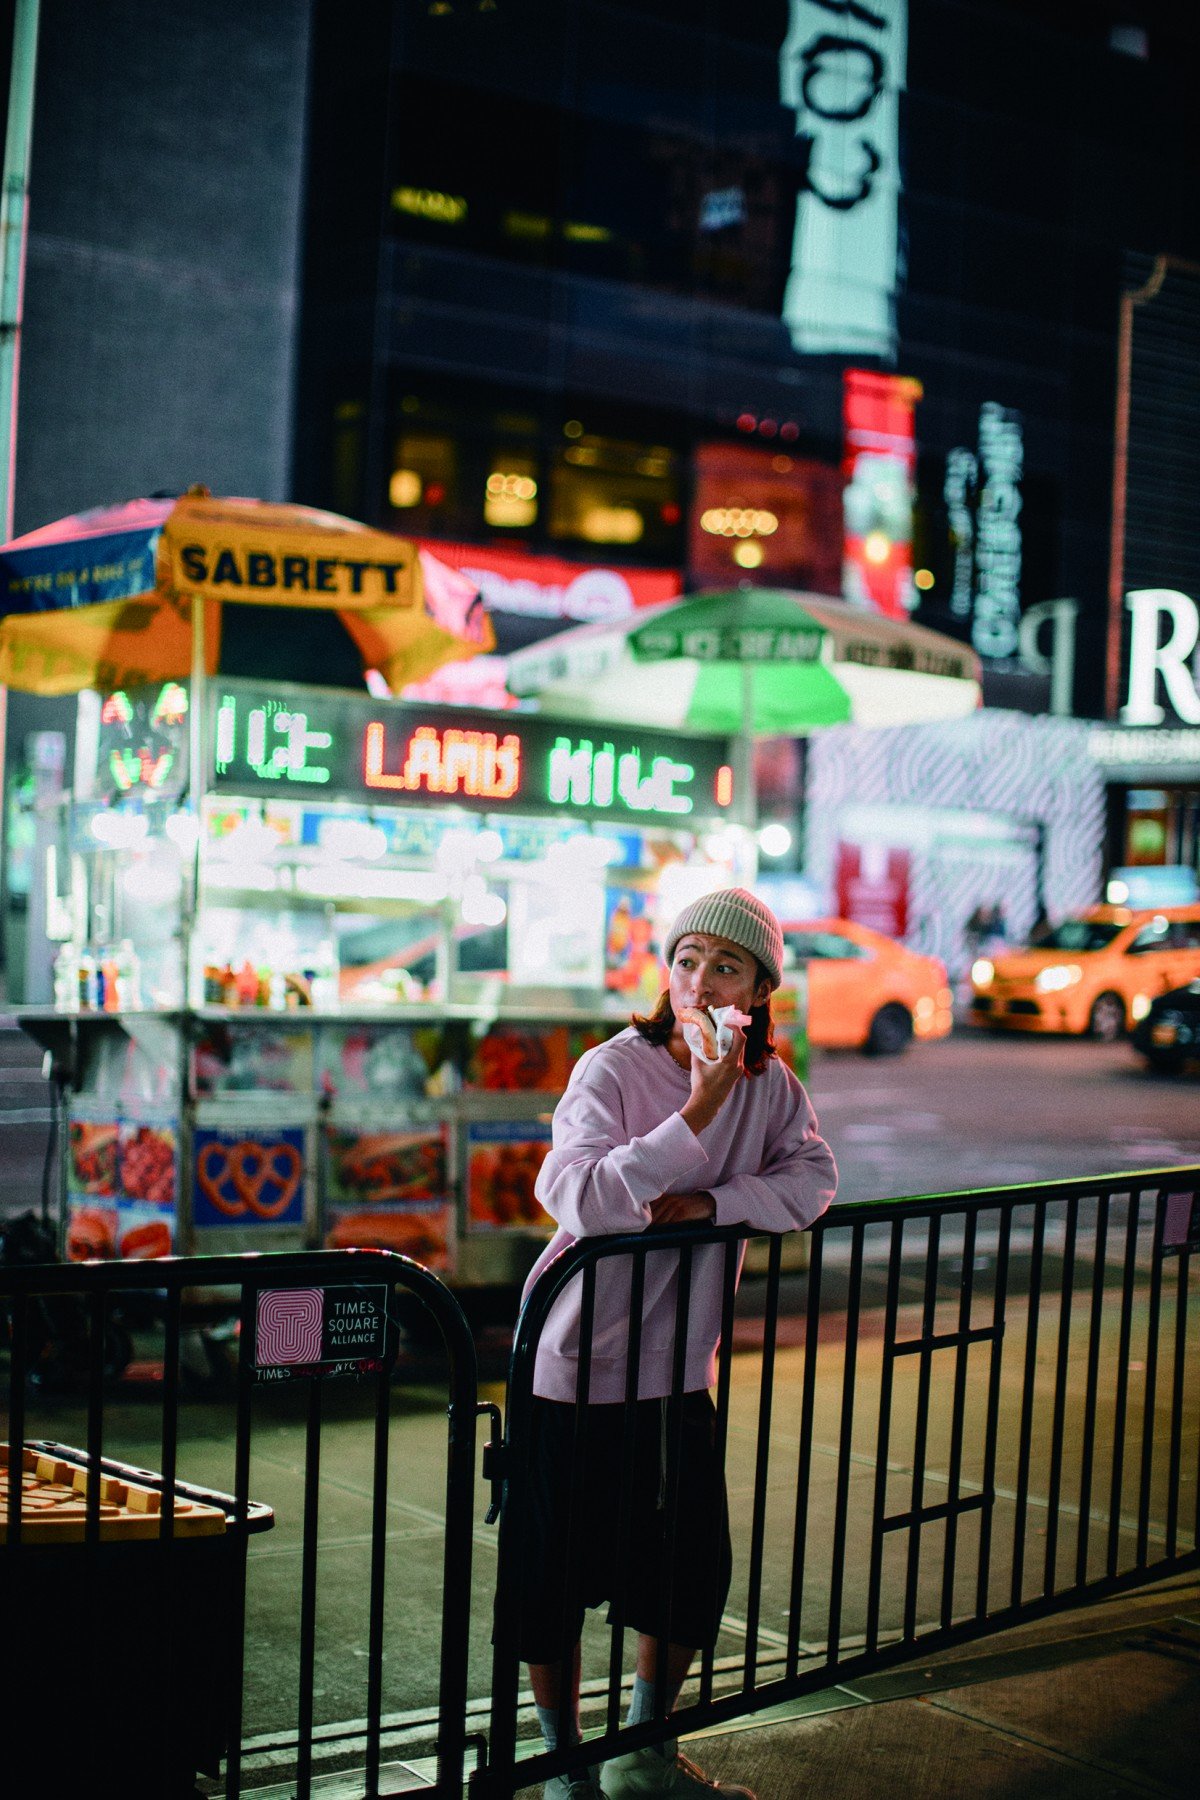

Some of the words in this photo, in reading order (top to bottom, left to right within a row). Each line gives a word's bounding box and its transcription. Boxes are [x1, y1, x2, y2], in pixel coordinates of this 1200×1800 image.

[180, 543, 404, 594] SABRETT
[334, 1301, 375, 1315] TIMES
[328, 1317, 379, 1334] SQUARE
[331, 1333, 375, 1345] ALLIANCE
